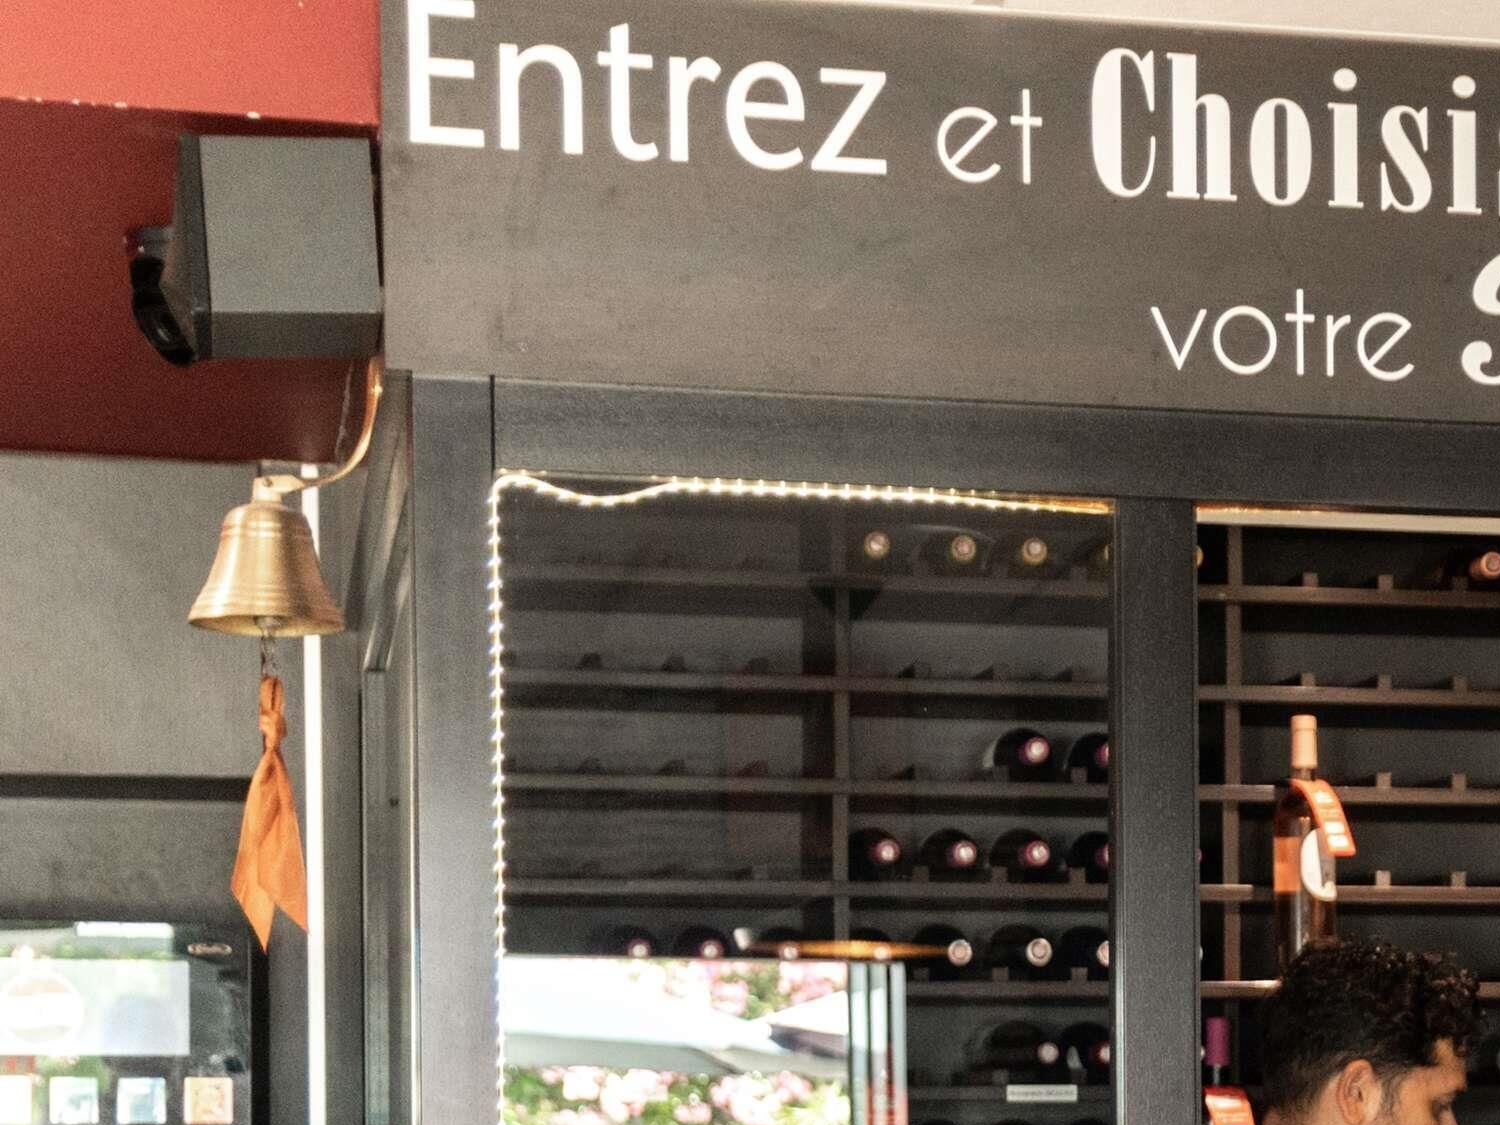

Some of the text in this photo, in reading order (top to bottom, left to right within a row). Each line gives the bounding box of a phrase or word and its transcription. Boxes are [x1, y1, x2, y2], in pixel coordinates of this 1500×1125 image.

[408, 0, 888, 174] Entrez
[937, 89, 1042, 184] et
[1151, 289, 1414, 380] votre
